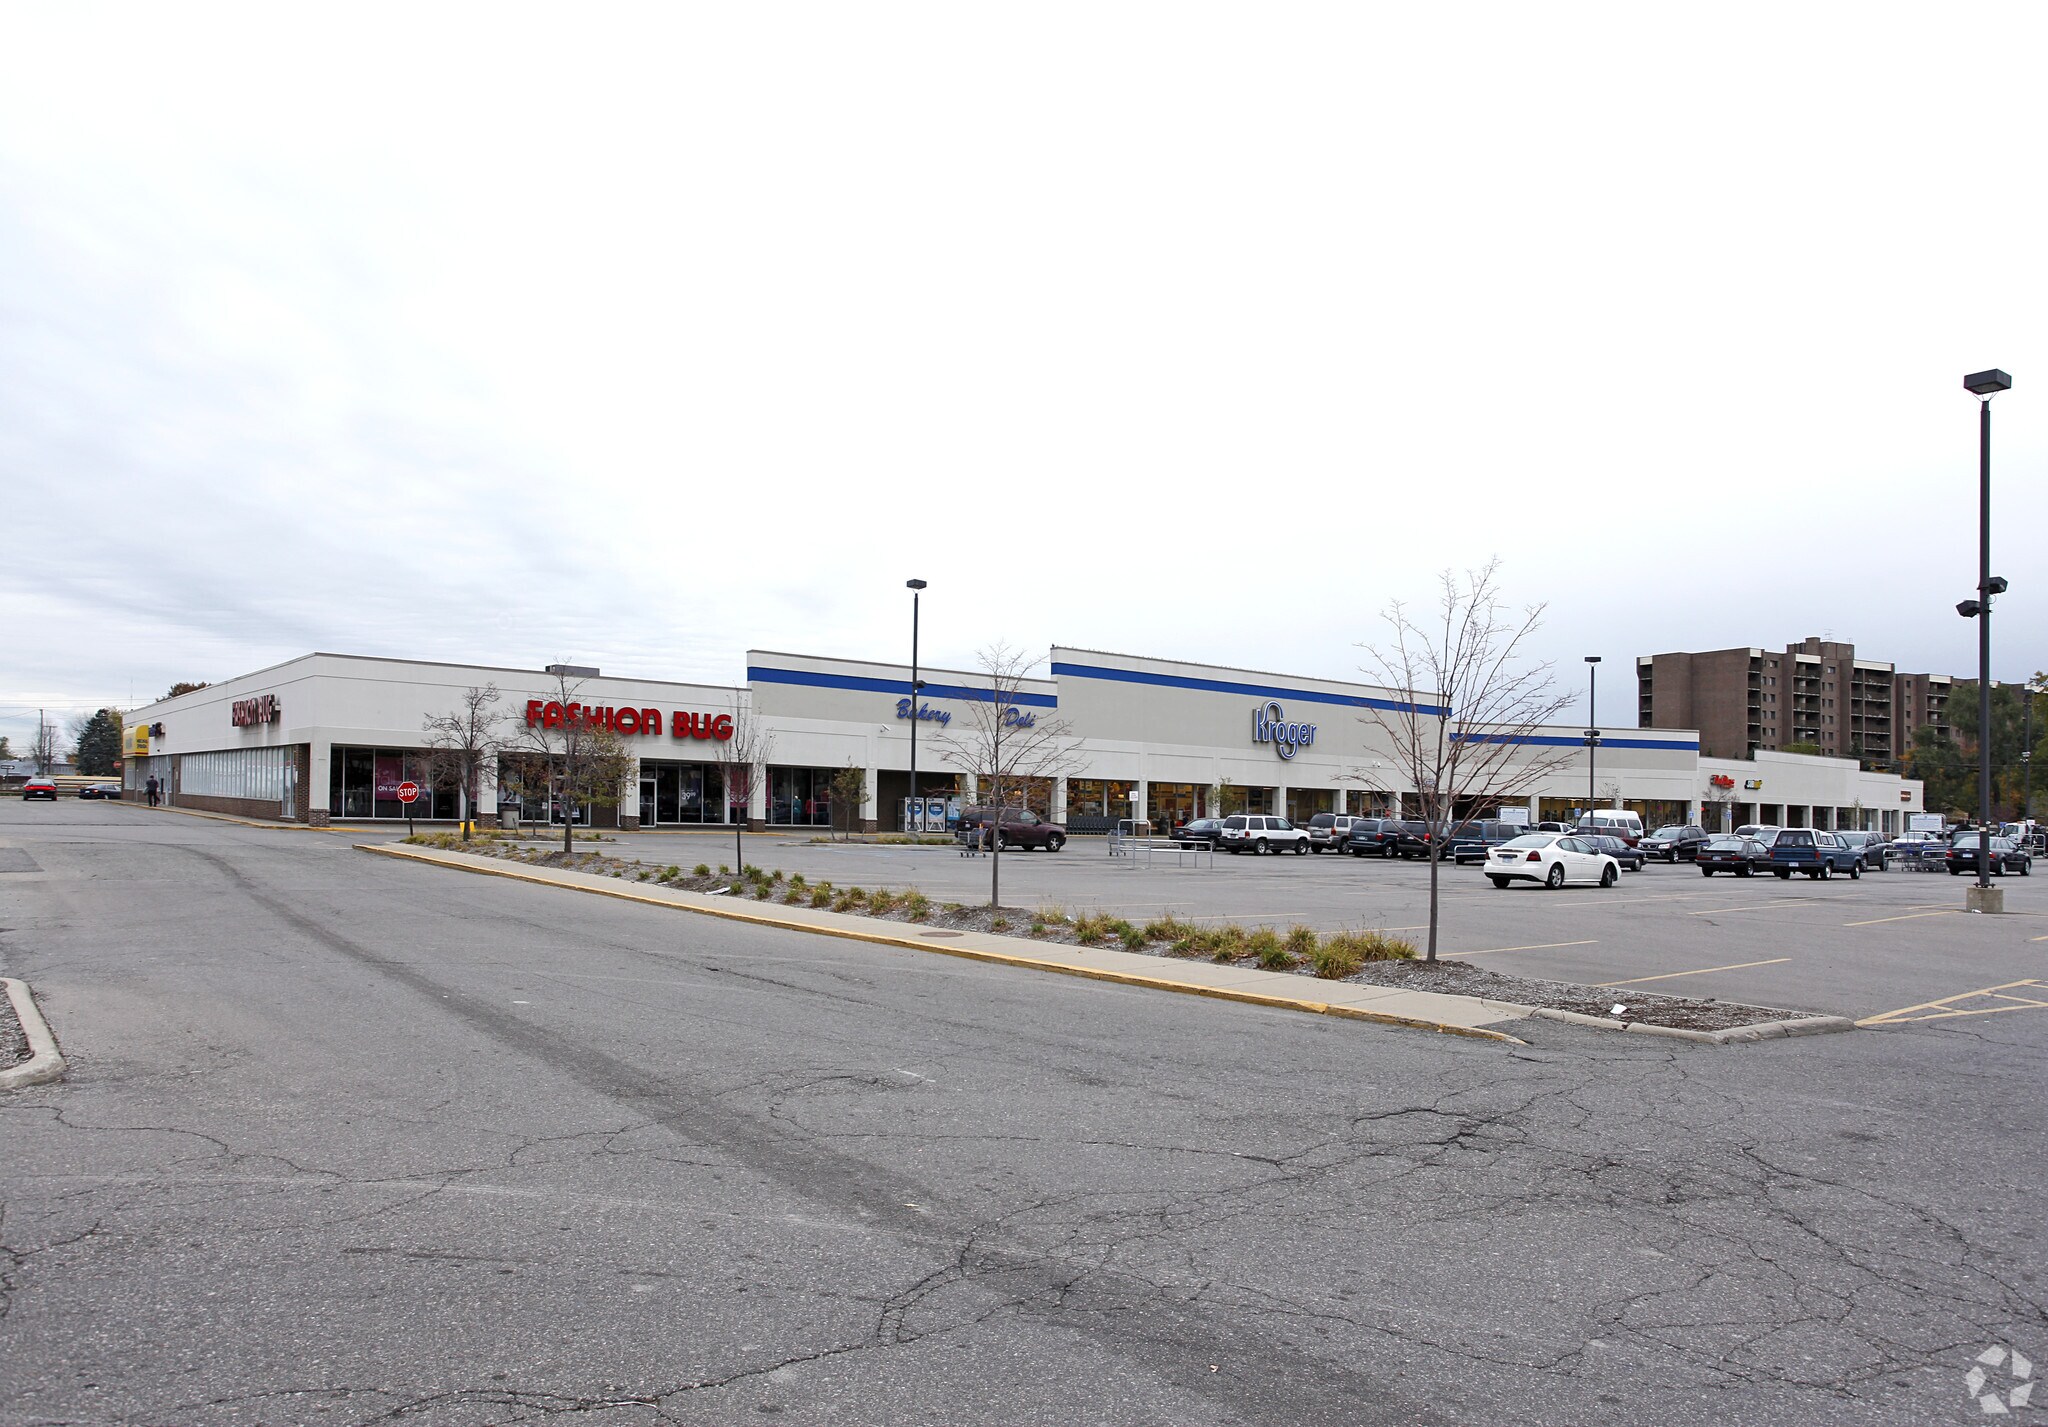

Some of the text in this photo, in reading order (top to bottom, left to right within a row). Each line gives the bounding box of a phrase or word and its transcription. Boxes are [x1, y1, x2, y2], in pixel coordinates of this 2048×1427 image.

[526, 700, 734, 740] FASHION BUG
[896, 698, 951, 728] Bakery
[1005, 707, 1036, 728] Deli
[1253, 700, 1317, 760] Kroger
[399, 787, 417, 797] STOP
